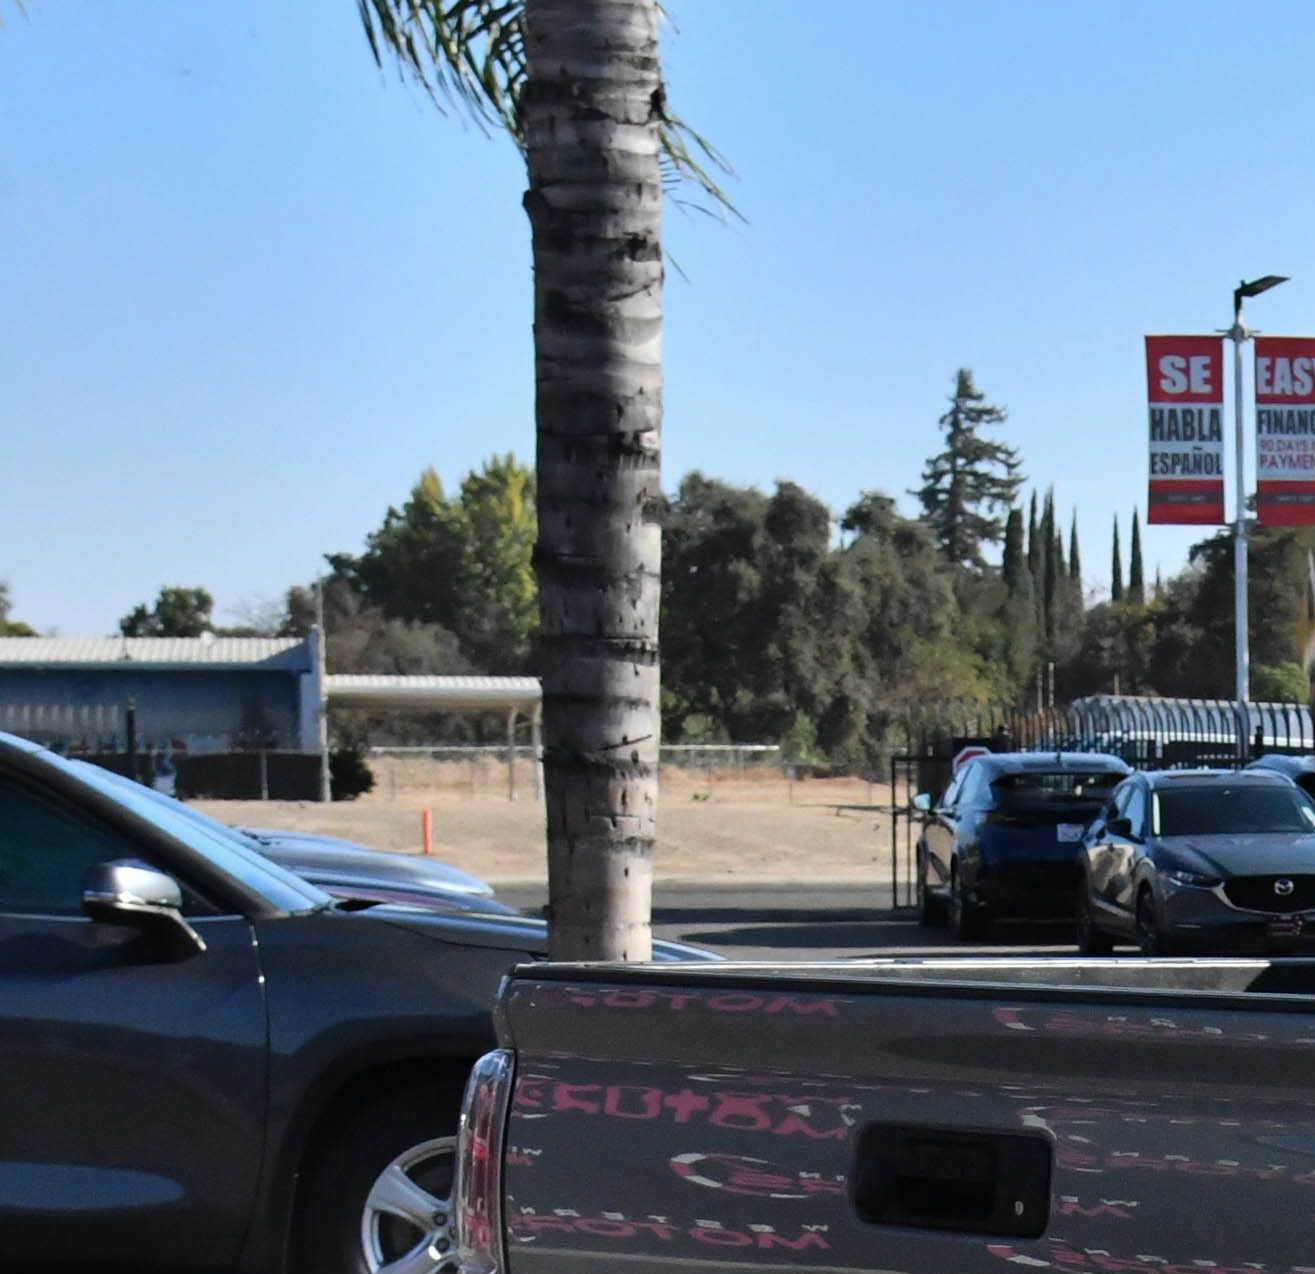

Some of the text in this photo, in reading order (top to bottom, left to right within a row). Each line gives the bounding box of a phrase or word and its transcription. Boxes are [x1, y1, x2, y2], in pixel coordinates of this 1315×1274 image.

[1158, 354, 1213, 394] SE
[1150, 407, 1222, 442] HABLA
[1150, 445, 1223, 475] ESPAÑOL
